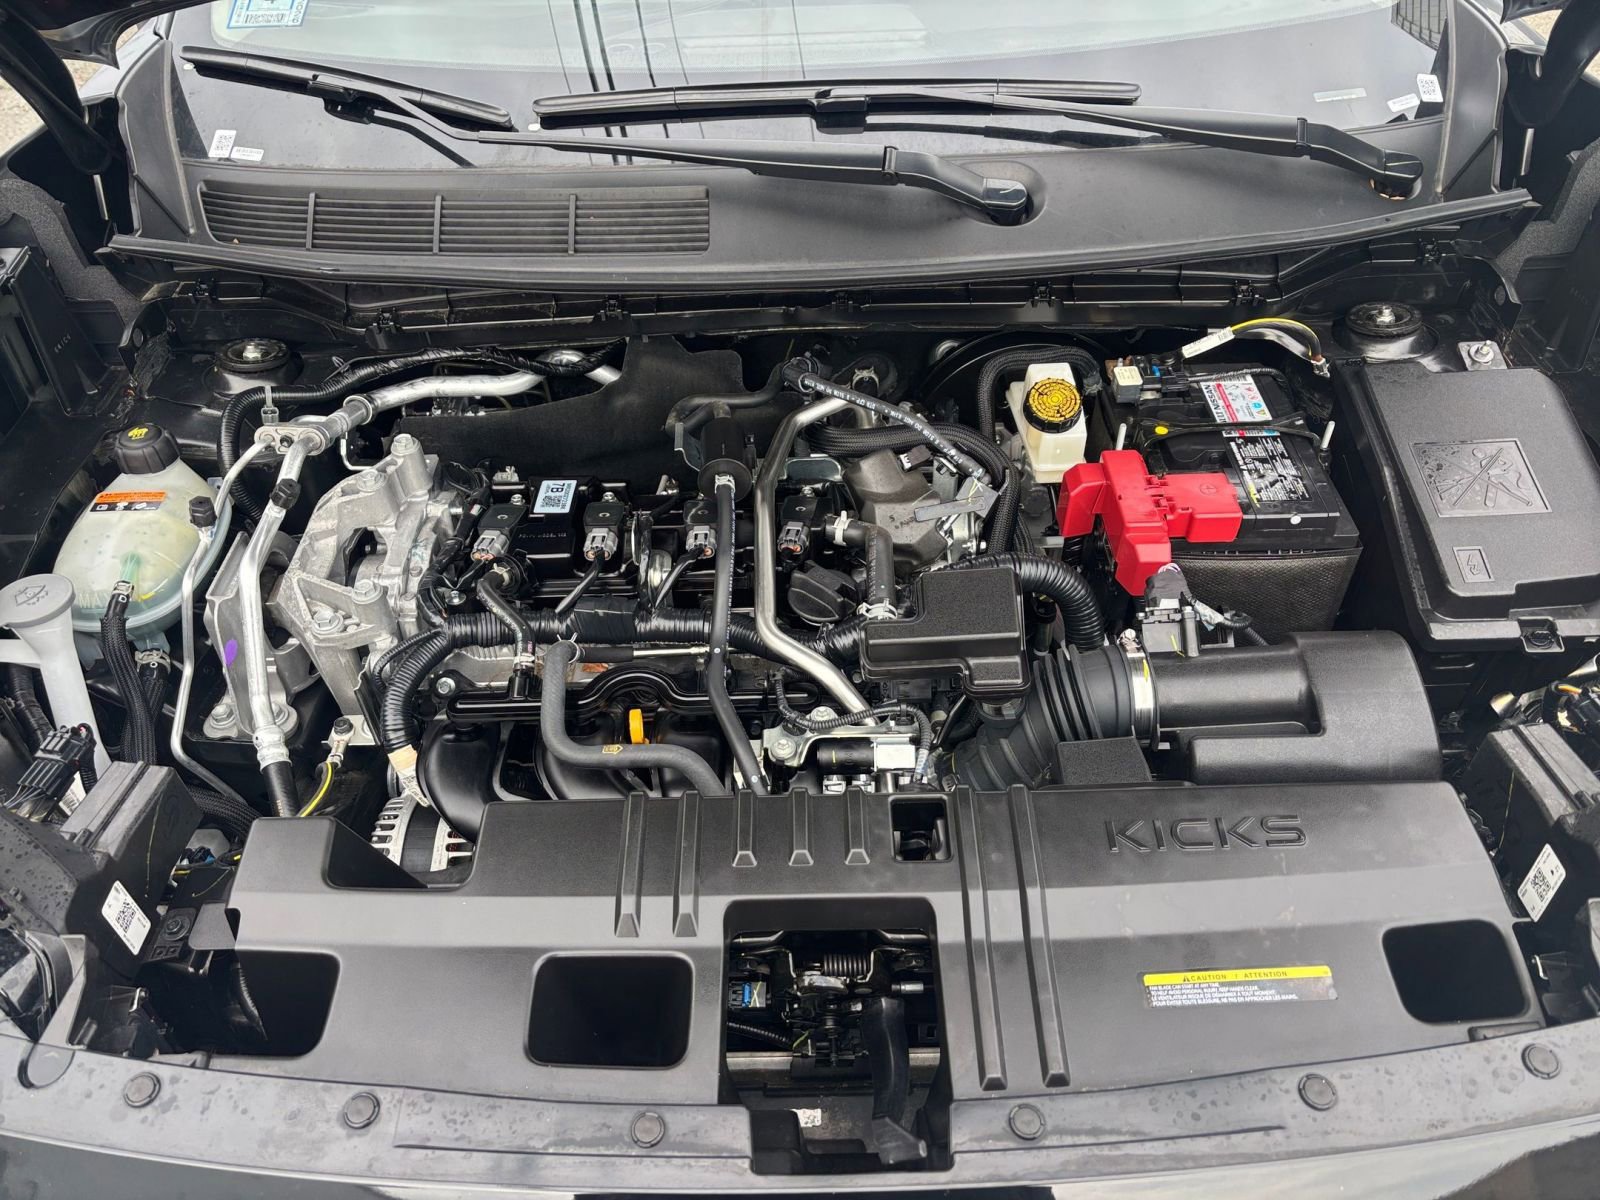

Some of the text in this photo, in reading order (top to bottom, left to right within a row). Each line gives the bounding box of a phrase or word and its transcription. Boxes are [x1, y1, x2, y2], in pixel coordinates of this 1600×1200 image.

[1203, 384, 1220, 410] NISSAN
[550, 482, 565, 493] 7B
[1105, 815, 1307, 852] KICKS
[1244, 970, 1288, 978] ATTENTION
